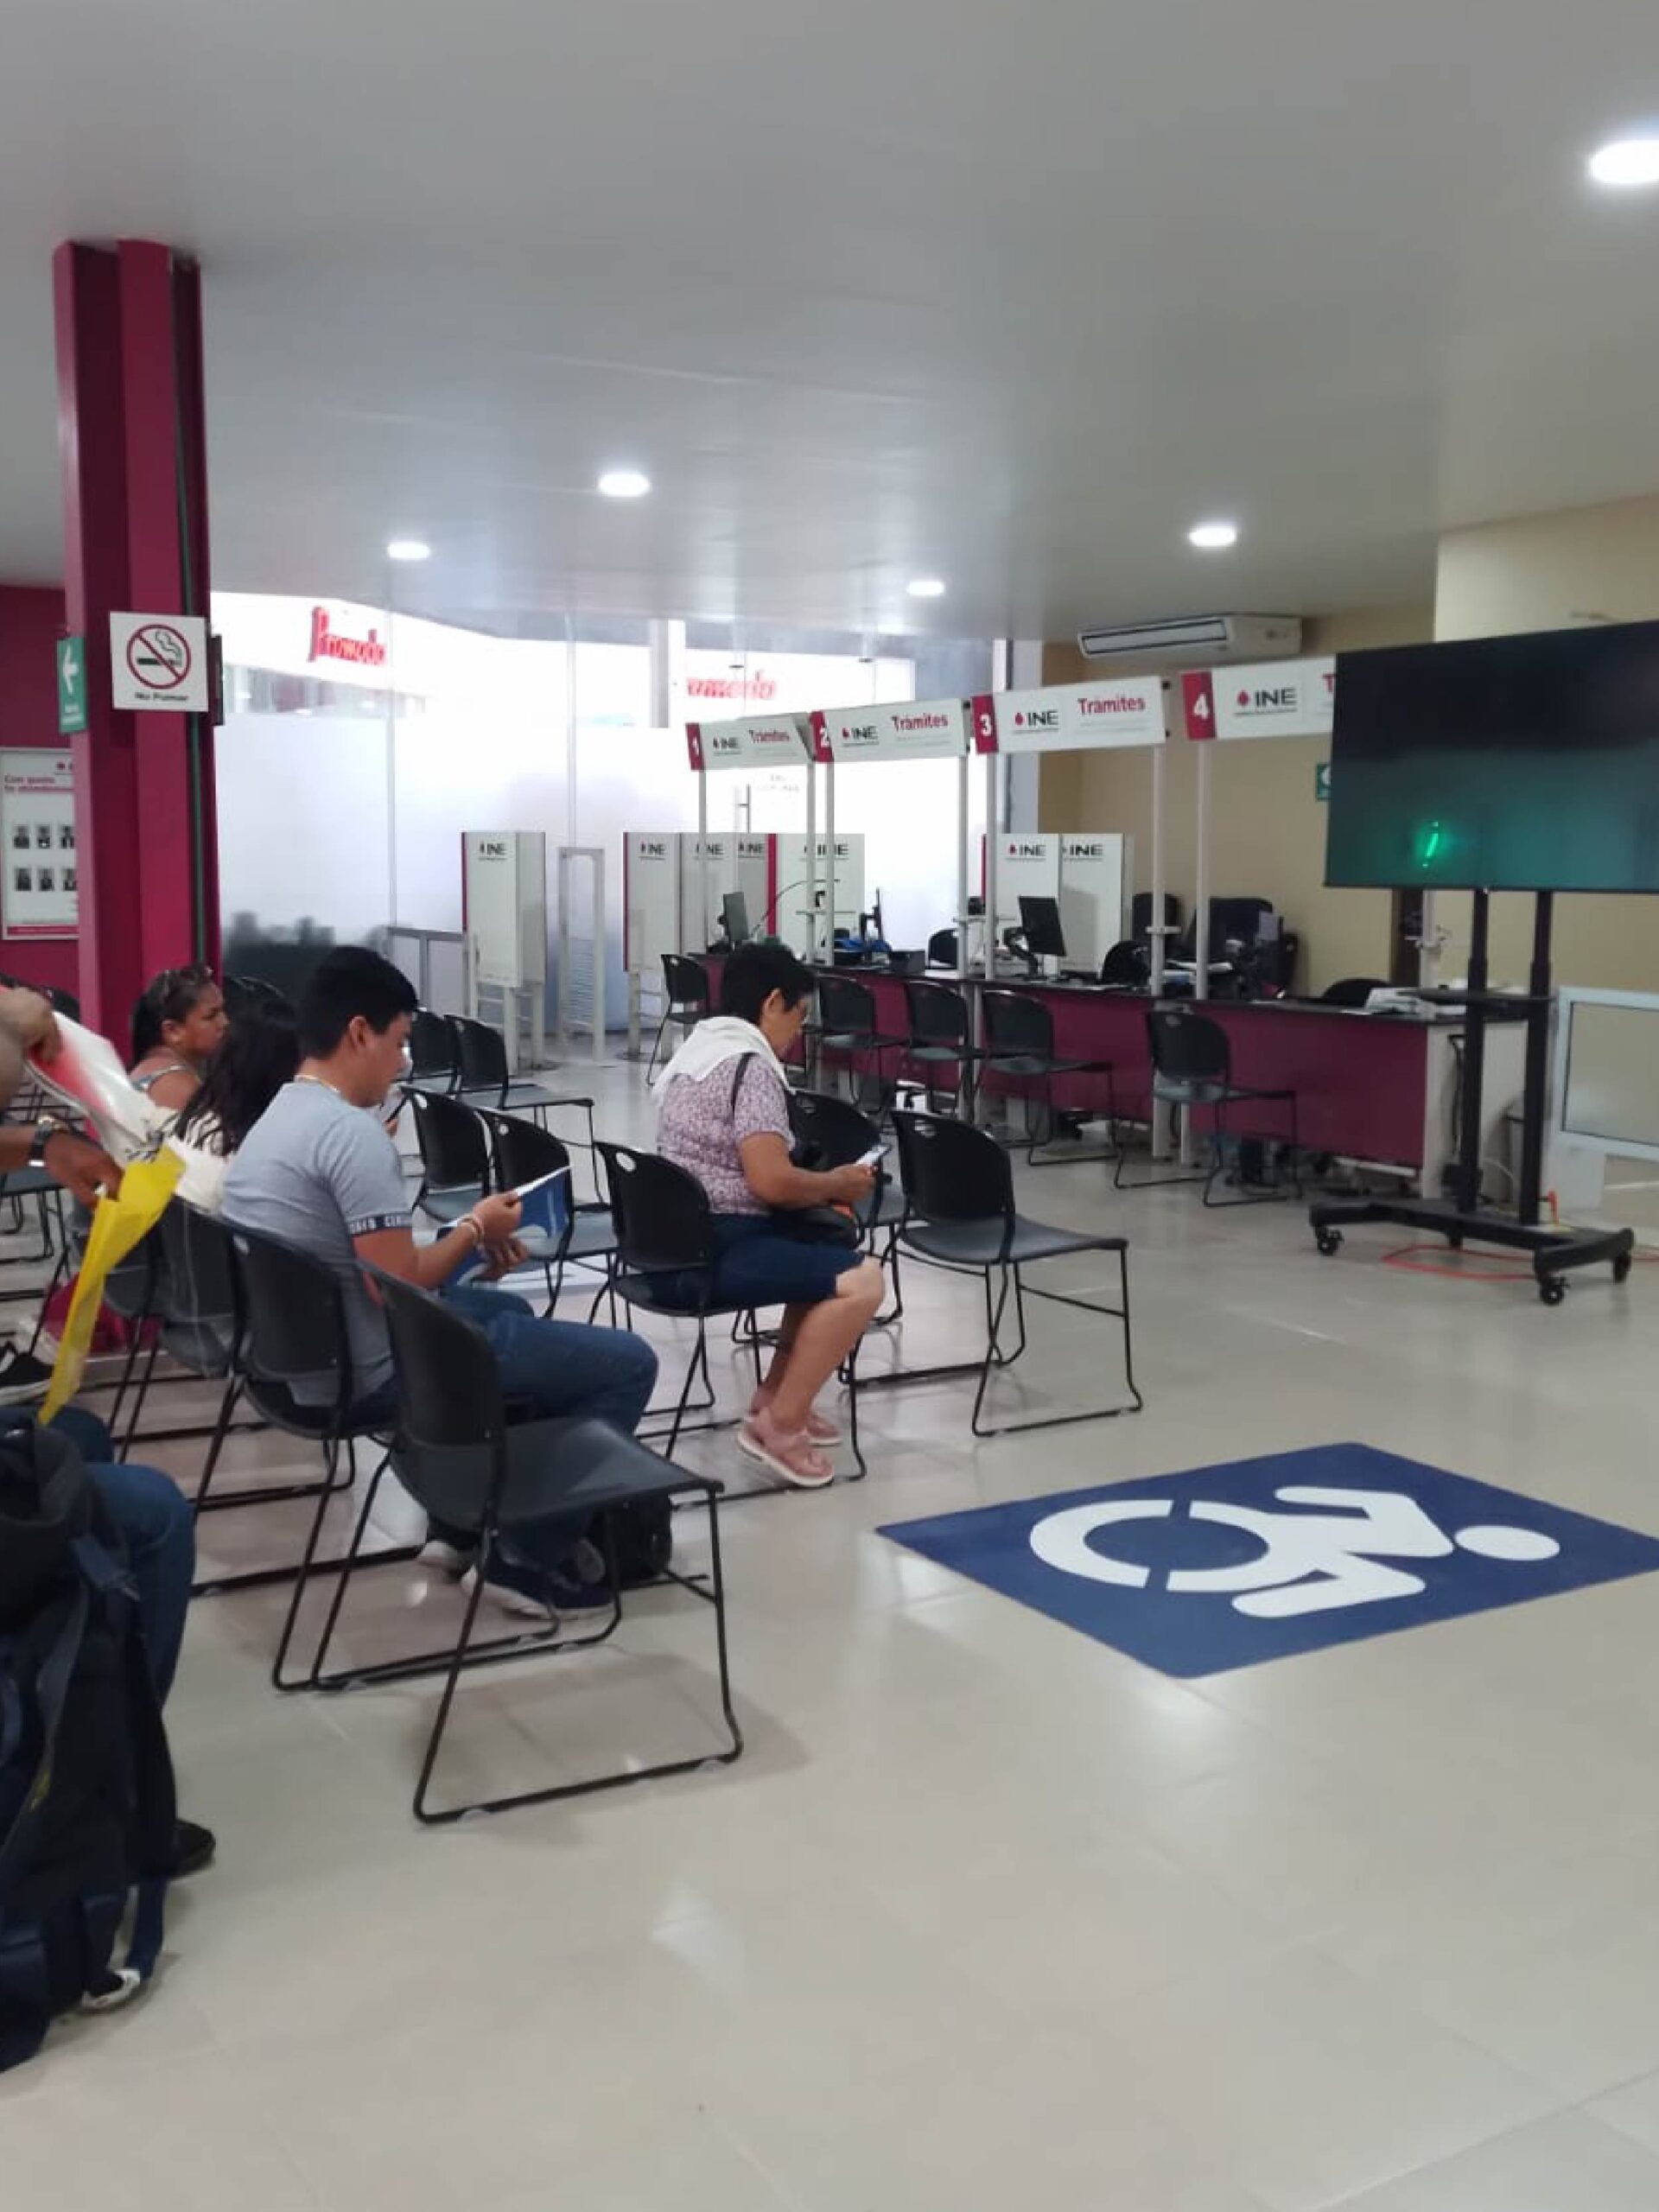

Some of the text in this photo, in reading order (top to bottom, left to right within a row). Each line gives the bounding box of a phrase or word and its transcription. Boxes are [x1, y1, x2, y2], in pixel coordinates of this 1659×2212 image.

[1193, 688, 1296, 720] 4 INE
[979, 712, 992, 736] 3
[1027, 709, 1058, 726] INE
[818, 727, 830, 747] 2
[852, 726, 878, 741] INE
[486, 843, 505, 855] INE
[649, 843, 665, 855] INE
[1020, 843, 1046, 855] INE
[1070, 843, 1103, 855] INE
